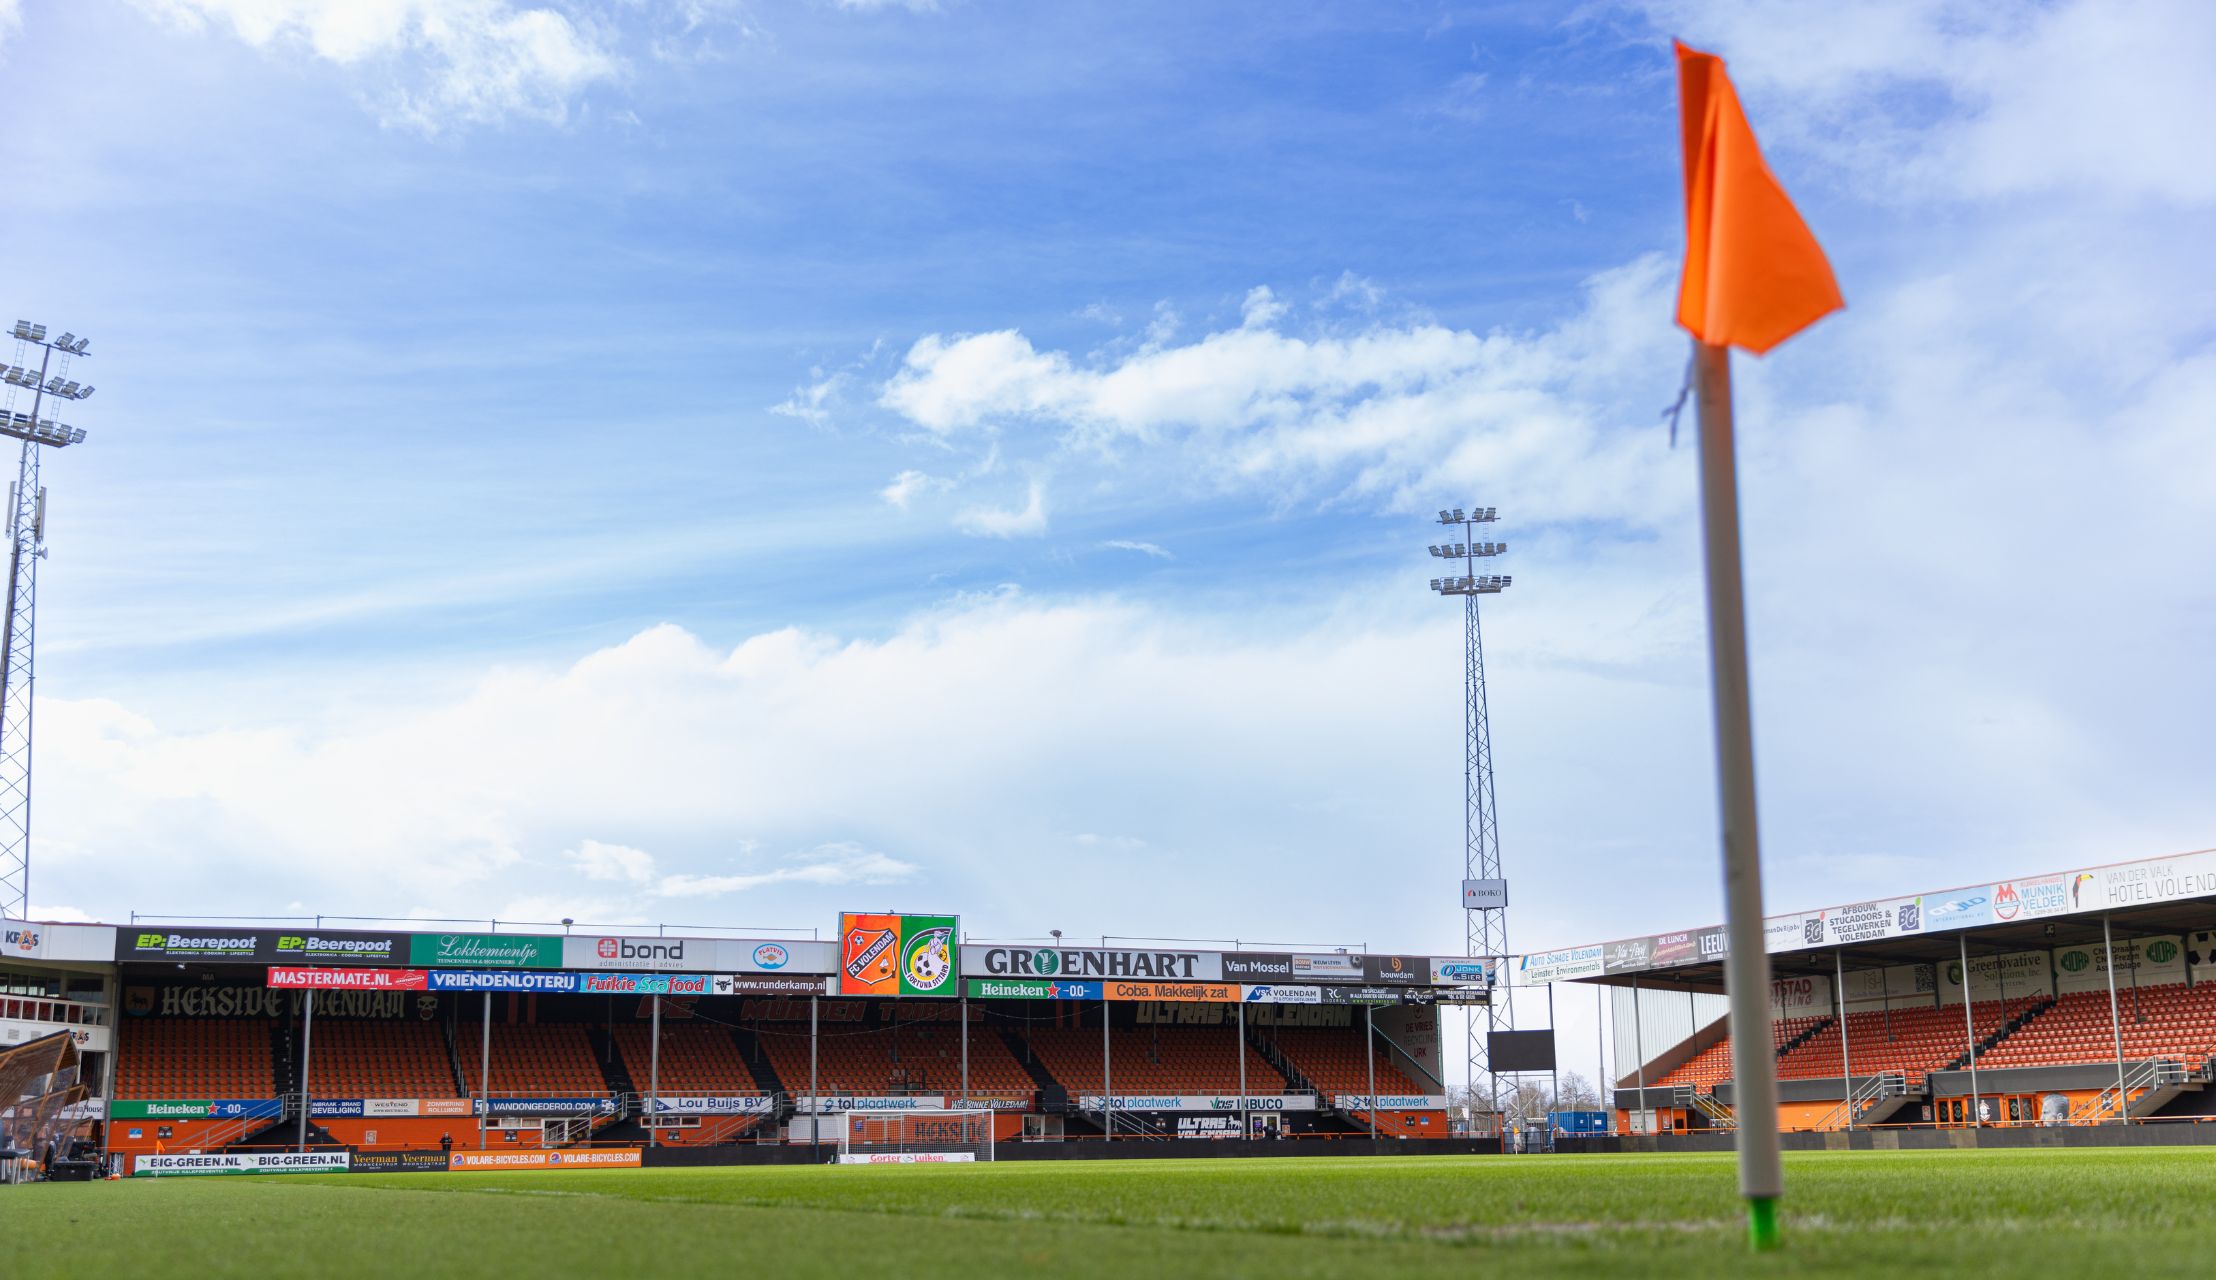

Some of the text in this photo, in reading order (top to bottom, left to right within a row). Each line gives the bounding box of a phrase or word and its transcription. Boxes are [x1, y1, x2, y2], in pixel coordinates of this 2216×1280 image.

[2107, 865, 2174, 884] VAN DER VALK
[1478, 889, 1502, 897] BOKO
[2021, 883, 2064, 899] MUNNIK
[2108, 883, 2152, 904] HOTEL
[2022, 896, 2065, 910] VELDER
[1829, 910, 1892, 926] STUCADOORS &
[1832, 919, 1892, 935] TEGELWERKEN
[5, 930, 39, 947] KRAS
[1658, 934, 1688, 945] DE LUNCH
[1839, 929, 1885, 942] VOLENDAM
[437, 934, 538, 965] Lokkemientje
[621, 939, 684, 960] bond
[758, 946, 784, 956] PLATVIS
[848, 931, 896, 976] FC VOLENDAM
[2111, 944, 2141, 953] Draaen
[984, 948, 1199, 978] GROENHART
[1530, 948, 1601, 967] AUTO SCHADE VOLENDAM
[1967, 953, 2041, 973] Greenovative
[1225, 960, 1290, 974] Van Mossel
[1456, 965, 1480, 973] JONK
[1531, 962, 1600, 979] Leinster Environmentals
[273, 971, 393, 986] MASTERMATE.NL
[906, 964, 949, 989] FORTUNA SITTARD
[1380, 970, 1414, 979] bouwdam
[433, 973, 575, 990] VRIENDENLOTERIJ
[586, 976, 705, 994] Fuikie Seafood
[734, 980, 826, 992] www.runderkamp.nl
[981, 983, 1044, 997] Heineken
[1116, 984, 1228, 1000] Coba. Makkelijk zat
[1255, 989, 1317, 998] VSK VOLENDAM
[160, 985, 285, 1017] HEKSIDE
[1136, 1001, 1353, 1027] ULTRAS VOLENDAM
[1405, 1021, 1434, 1033] DE VRIES
[1413, 1047, 1427, 1058] URK
[84, 1104, 104, 1113] House
[493, 1102, 596, 1111] VANDONGEDEROO.COM
[678, 1097, 764, 1110] Lou Buijs BV
[837, 1097, 917, 1110] tol plaatwerk
[1110, 1096, 1182, 1109] tol plaatwerk
[1379, 1096, 1429, 1108] plaatwerk
[147, 1104, 204, 1114] Heineken
[311, 1106, 361, 1114] BEVEILIGING
[1177, 1117, 1227, 1129] ULTRAS
[1177, 1129, 1241, 1139] VOLENDAM
[150, 1156, 241, 1168] BIG-GREEN.NL
[258, 1155, 346, 1166] BIG-GREEN.NL
[353, 1154, 398, 1163] Veerman
[402, 1154, 446, 1163] Veerman
[466, 1154, 545, 1165] VOLARE-BICYCLES.COM
[563, 1153, 640, 1163] VOLARE-BICYCLES.COM
[870, 1153, 944, 1163] Gorter Luiken
